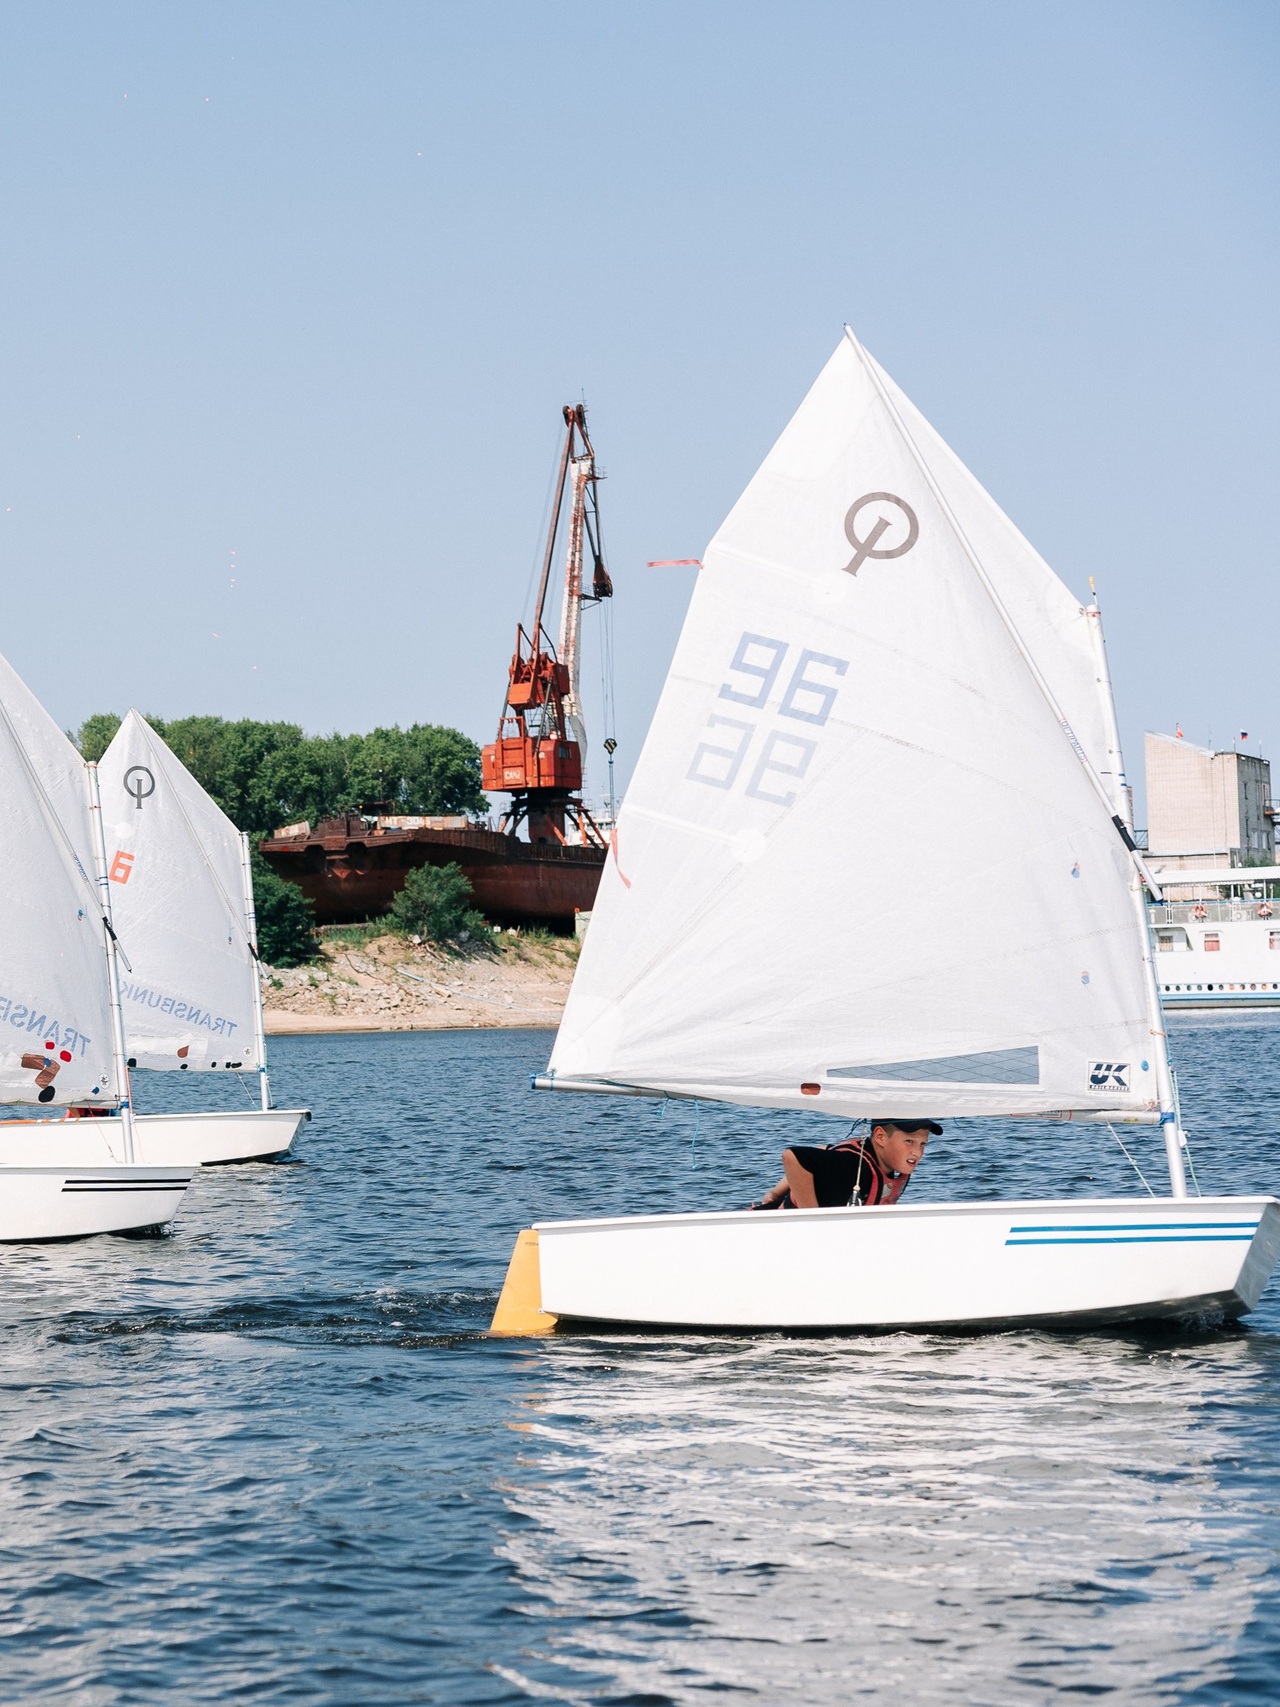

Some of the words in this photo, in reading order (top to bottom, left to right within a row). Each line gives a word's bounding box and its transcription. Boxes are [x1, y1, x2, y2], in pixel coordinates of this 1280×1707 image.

[718, 631, 850, 727] 96
[109, 850, 135, 884] 6
[1090, 1063, 1128, 1087] UK
